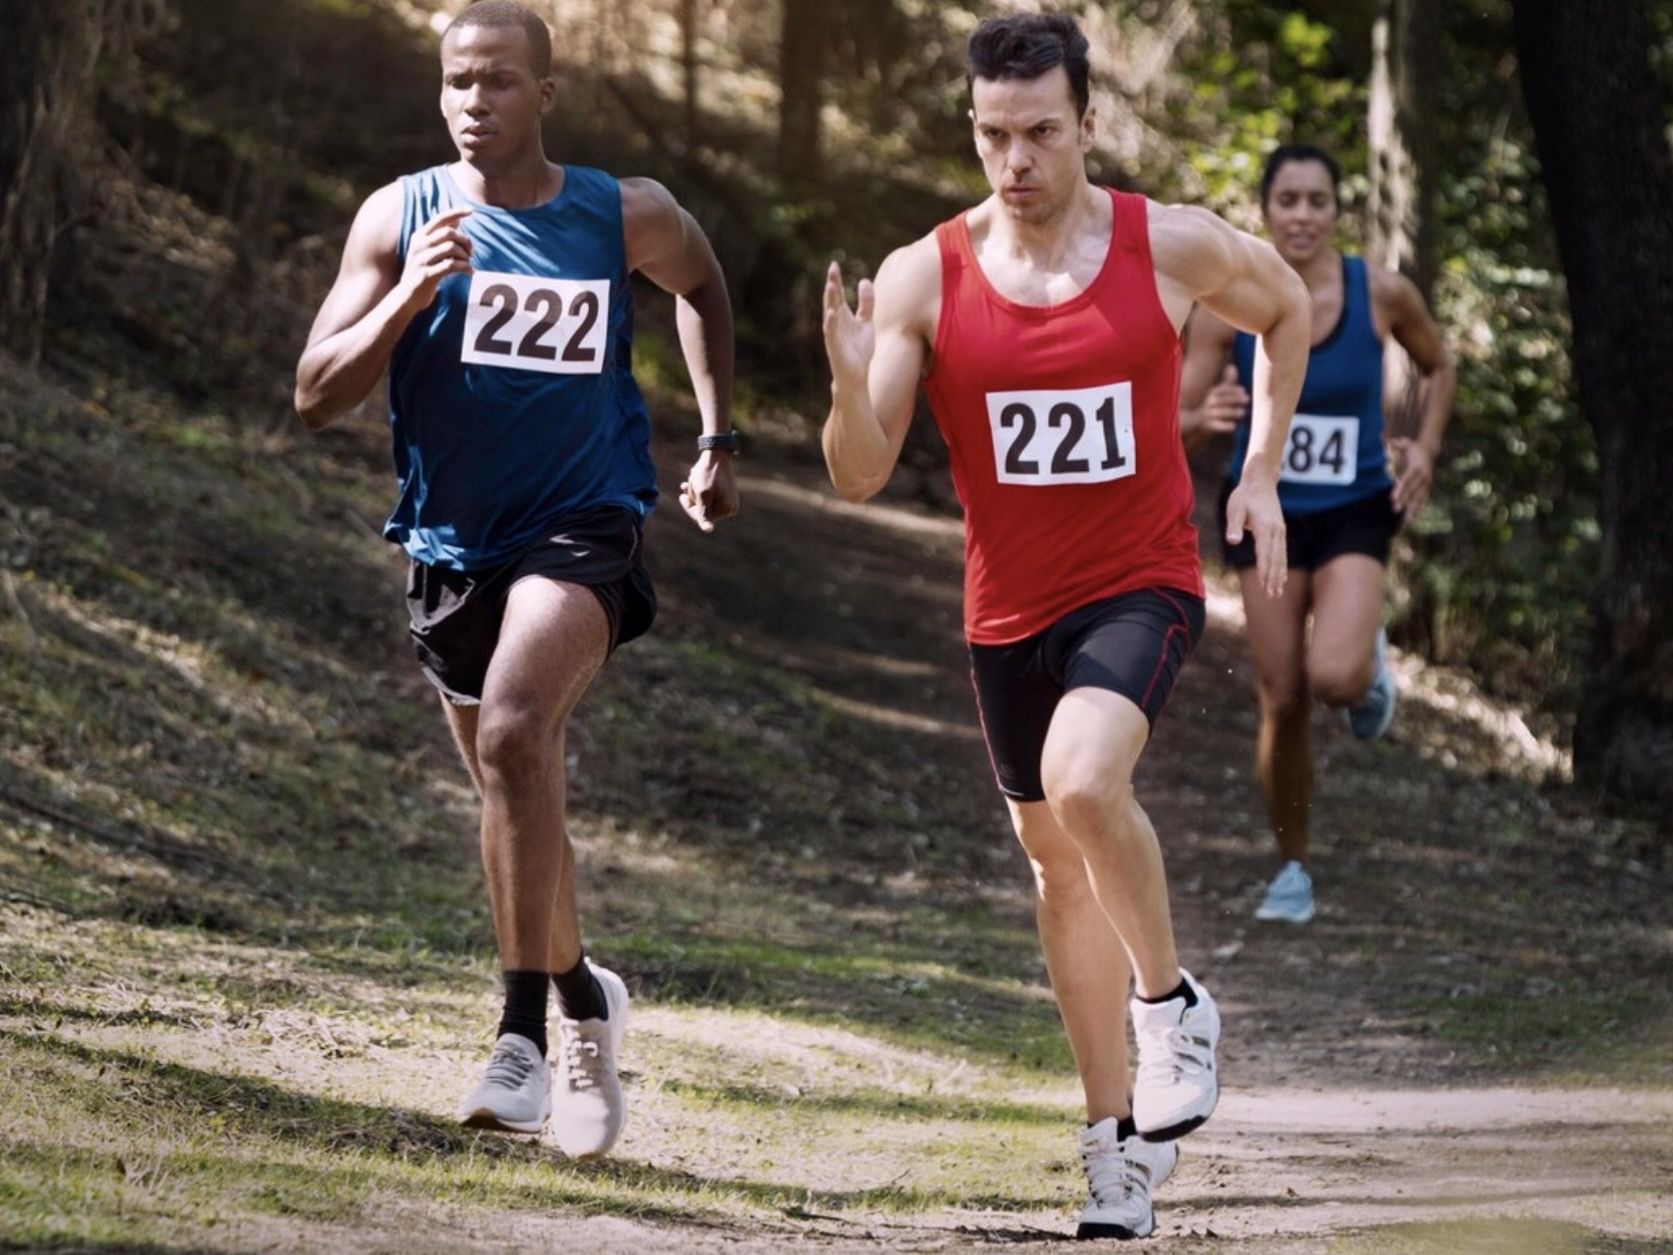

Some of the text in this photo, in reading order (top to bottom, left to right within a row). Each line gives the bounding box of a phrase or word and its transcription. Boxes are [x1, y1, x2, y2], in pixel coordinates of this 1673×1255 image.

[473, 283, 599, 362] 222
[1000, 396, 1126, 475] 221
[1281, 426, 1346, 475] 84
